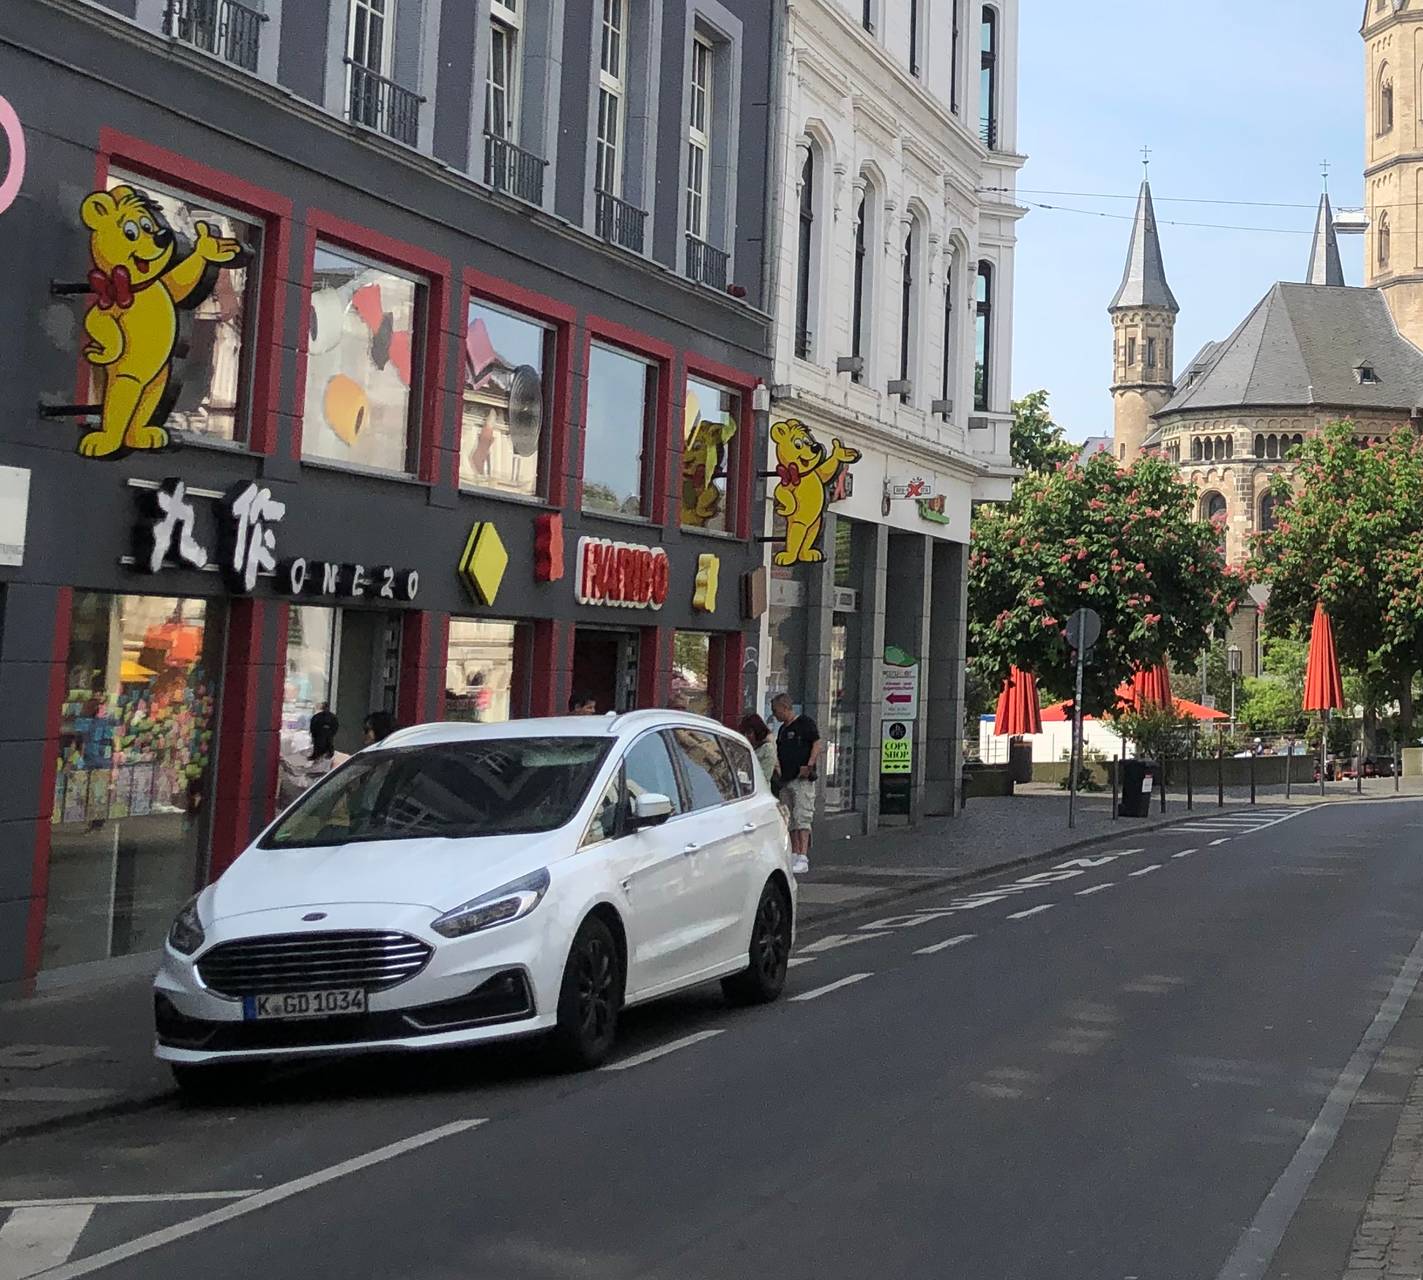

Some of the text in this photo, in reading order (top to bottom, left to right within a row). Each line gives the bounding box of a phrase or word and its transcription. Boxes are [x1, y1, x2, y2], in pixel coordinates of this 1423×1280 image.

[576, 536, 670, 610] HARIBO
[884, 742, 908, 751] COPY
[884, 751, 909, 759] SHOP
[257, 996, 270, 1016] K
